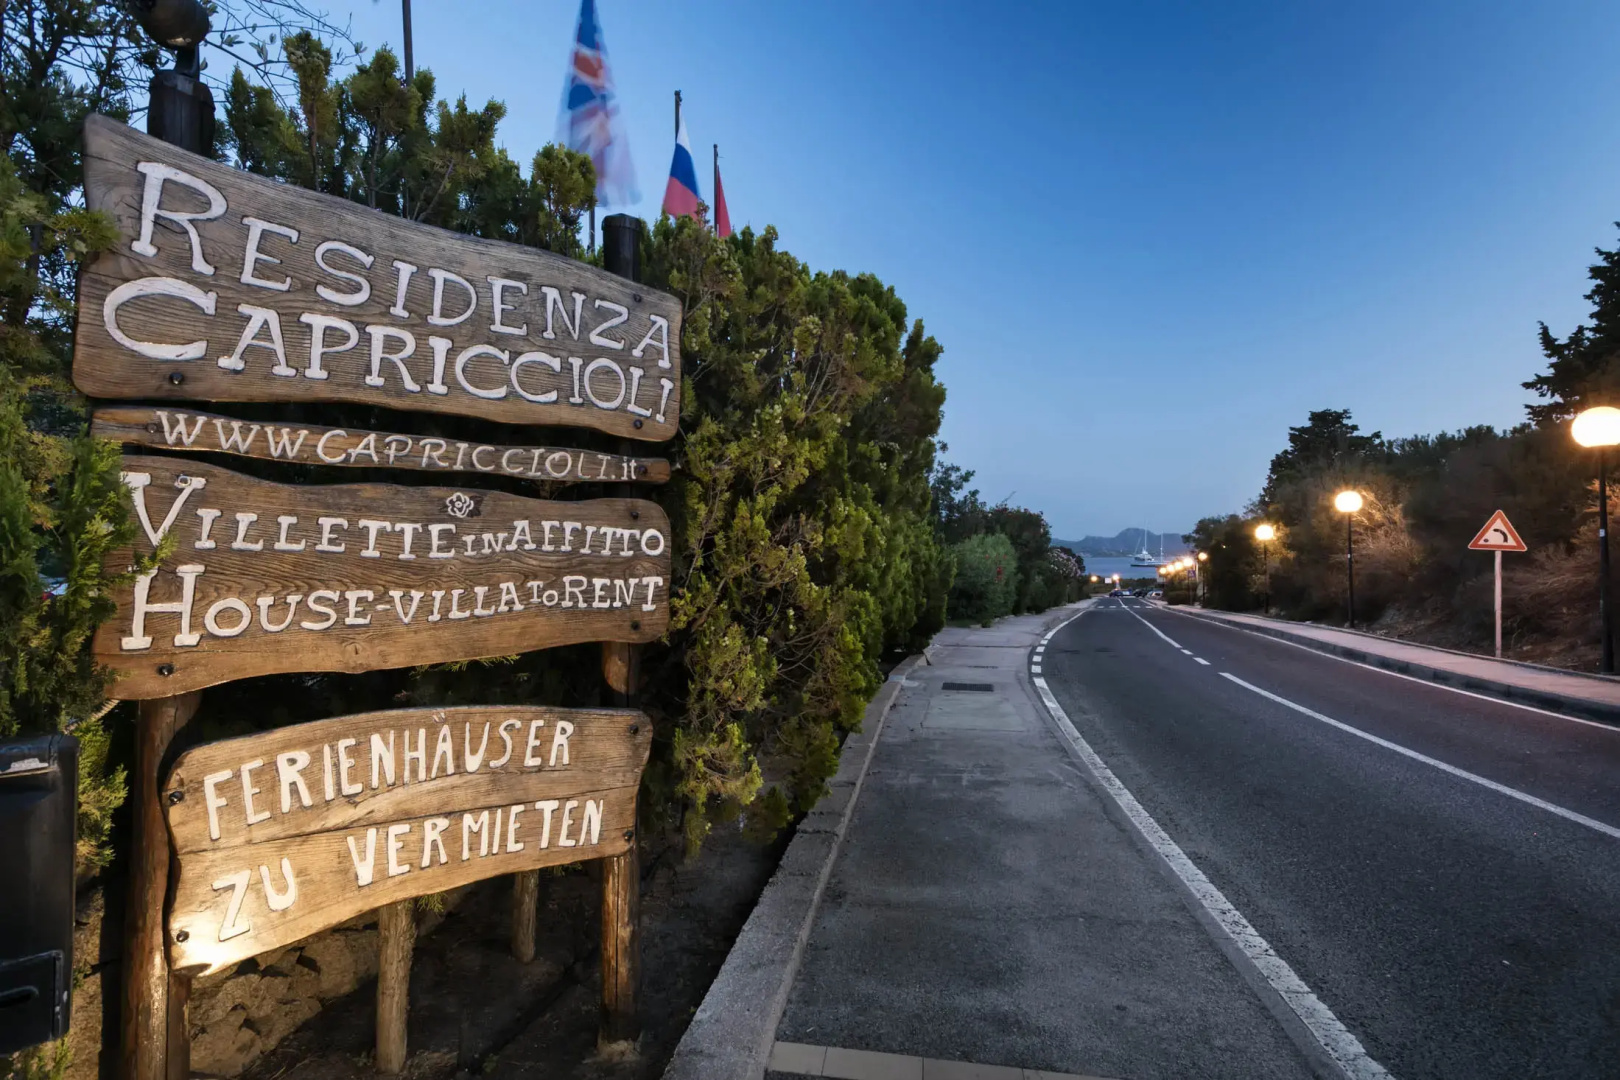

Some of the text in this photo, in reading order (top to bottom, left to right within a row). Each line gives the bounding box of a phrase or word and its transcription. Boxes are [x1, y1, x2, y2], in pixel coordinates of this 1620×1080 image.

[131, 161, 672, 369] RESIDENZA
[103, 276, 674, 424] CAPRICCIOLI
[120, 471, 456, 559] VILLETTE
[505, 519, 665, 556] AFFITTO
[561, 576, 664, 612] RENT
[211, 799, 604, 942] ZU VERMIETEN
